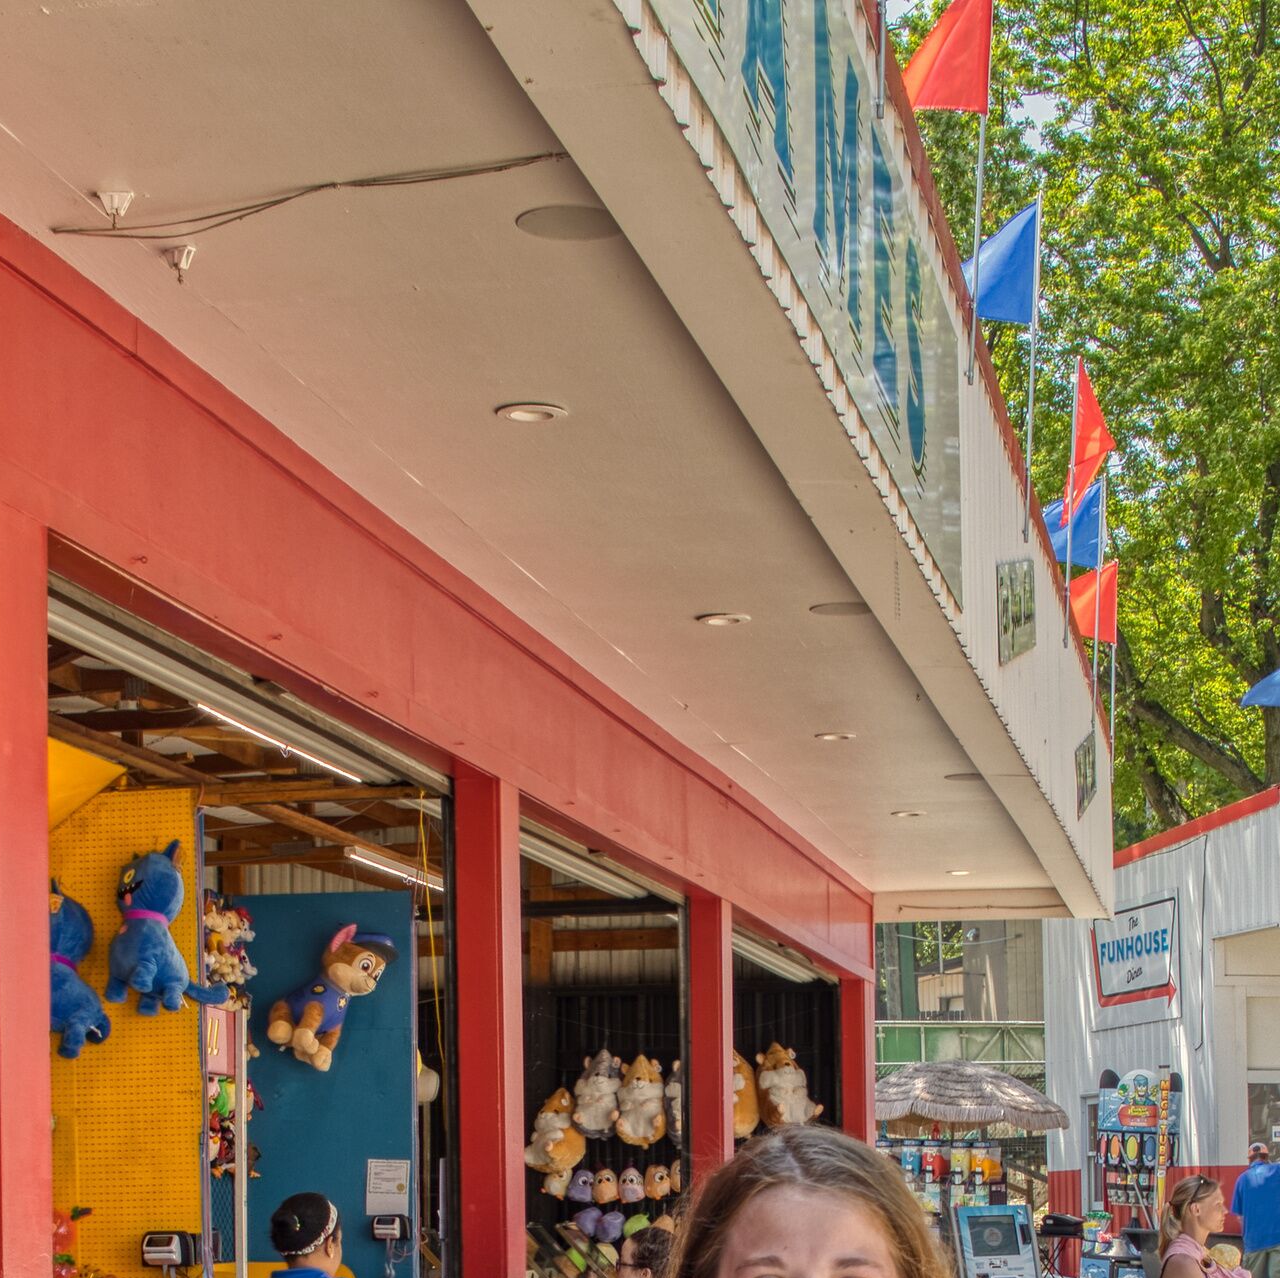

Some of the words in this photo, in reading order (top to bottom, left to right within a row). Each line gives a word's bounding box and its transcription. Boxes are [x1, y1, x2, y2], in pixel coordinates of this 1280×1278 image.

[1128, 916, 1139, 932] The
[1100, 928, 1169, 966] FUNHOUSE
[1126, 966, 1143, 984] Diner
[1160, 1079, 1170, 1121] MEGA
[1159, 1123, 1169, 1166] TUBE
